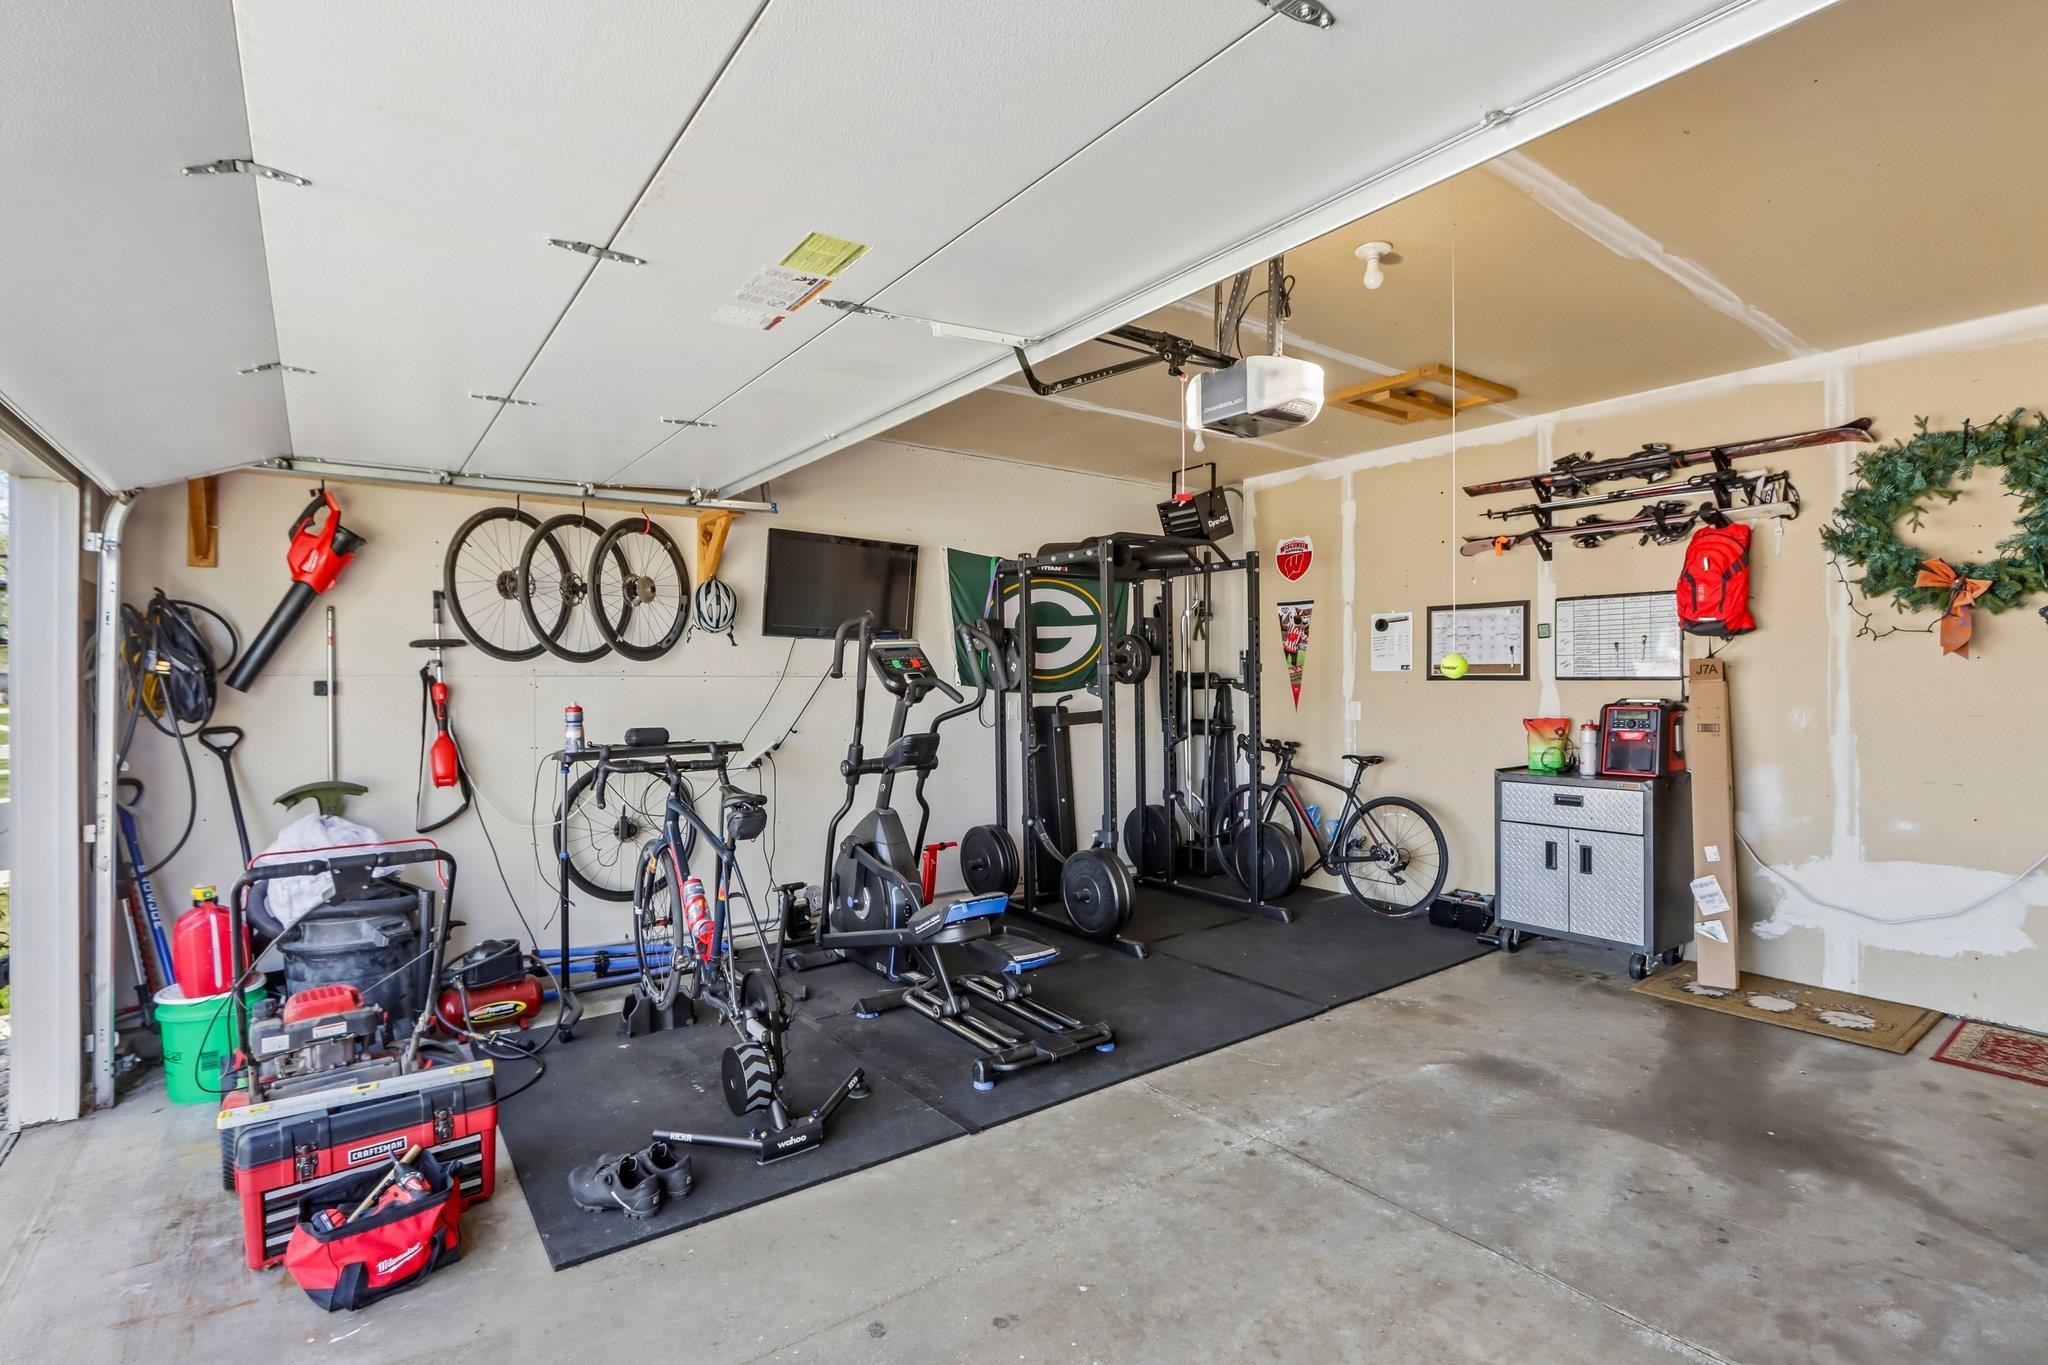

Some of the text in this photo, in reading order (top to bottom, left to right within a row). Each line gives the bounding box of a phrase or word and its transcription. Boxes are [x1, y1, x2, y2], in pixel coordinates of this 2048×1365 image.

[1280, 541, 1309, 553] WISCONSIN
[1003, 588, 1097, 670] G
[1696, 664, 1718, 675] J7A
[669, 1132, 693, 1142] KICKR
[777, 1135, 807, 1148] wahoo
[352, 1140, 404, 1161] CRAFTSMAN
